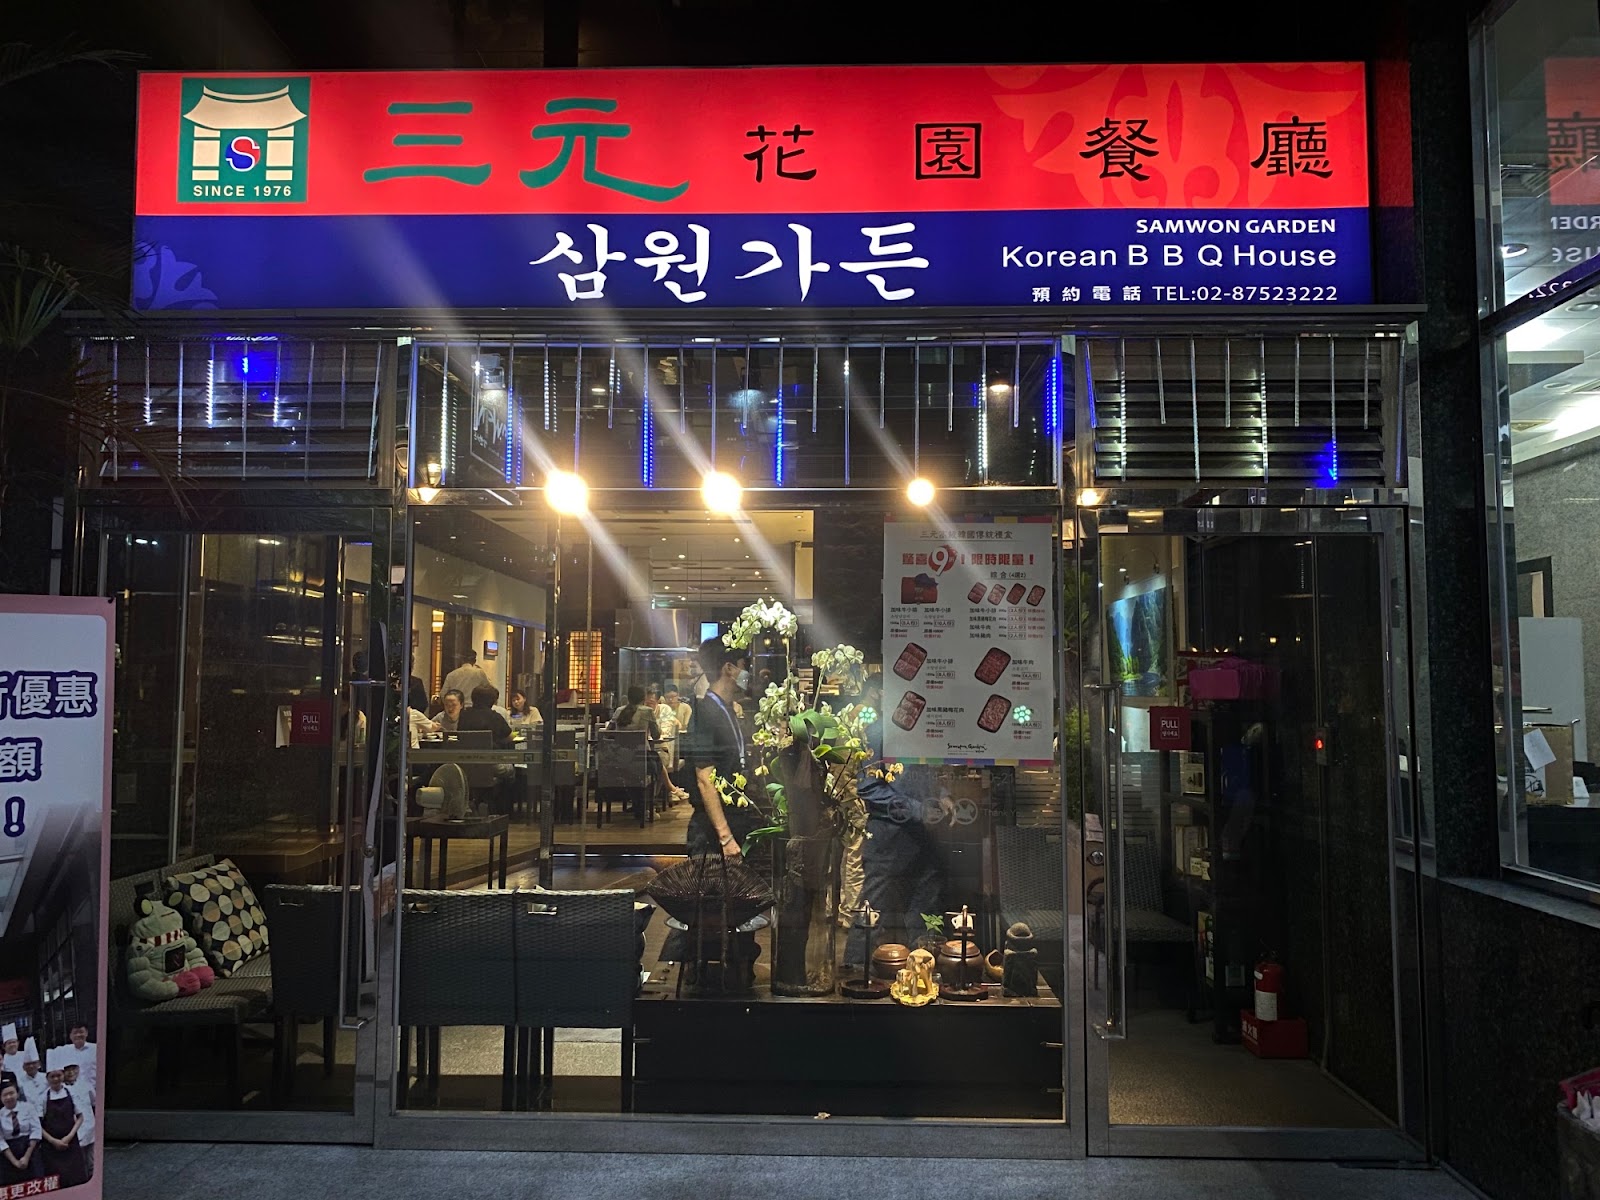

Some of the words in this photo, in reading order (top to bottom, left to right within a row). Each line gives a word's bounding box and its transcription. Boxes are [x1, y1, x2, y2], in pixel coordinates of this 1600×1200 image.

[193, 185, 245, 197] SINCE
[254, 185, 292, 197] 1976
[1136, 219, 1240, 234] SAMWON
[1245, 218, 1336, 234] GARDEN
[1002, 245, 1118, 268] Korean
[1233, 244, 1337, 267] House
[1031, 285, 1142, 303] 預約電話
[1151, 286, 1338, 302] TEL:02-87523222
[302, 715, 318, 724] PULL
[1161, 720, 1178, 729] PULL
